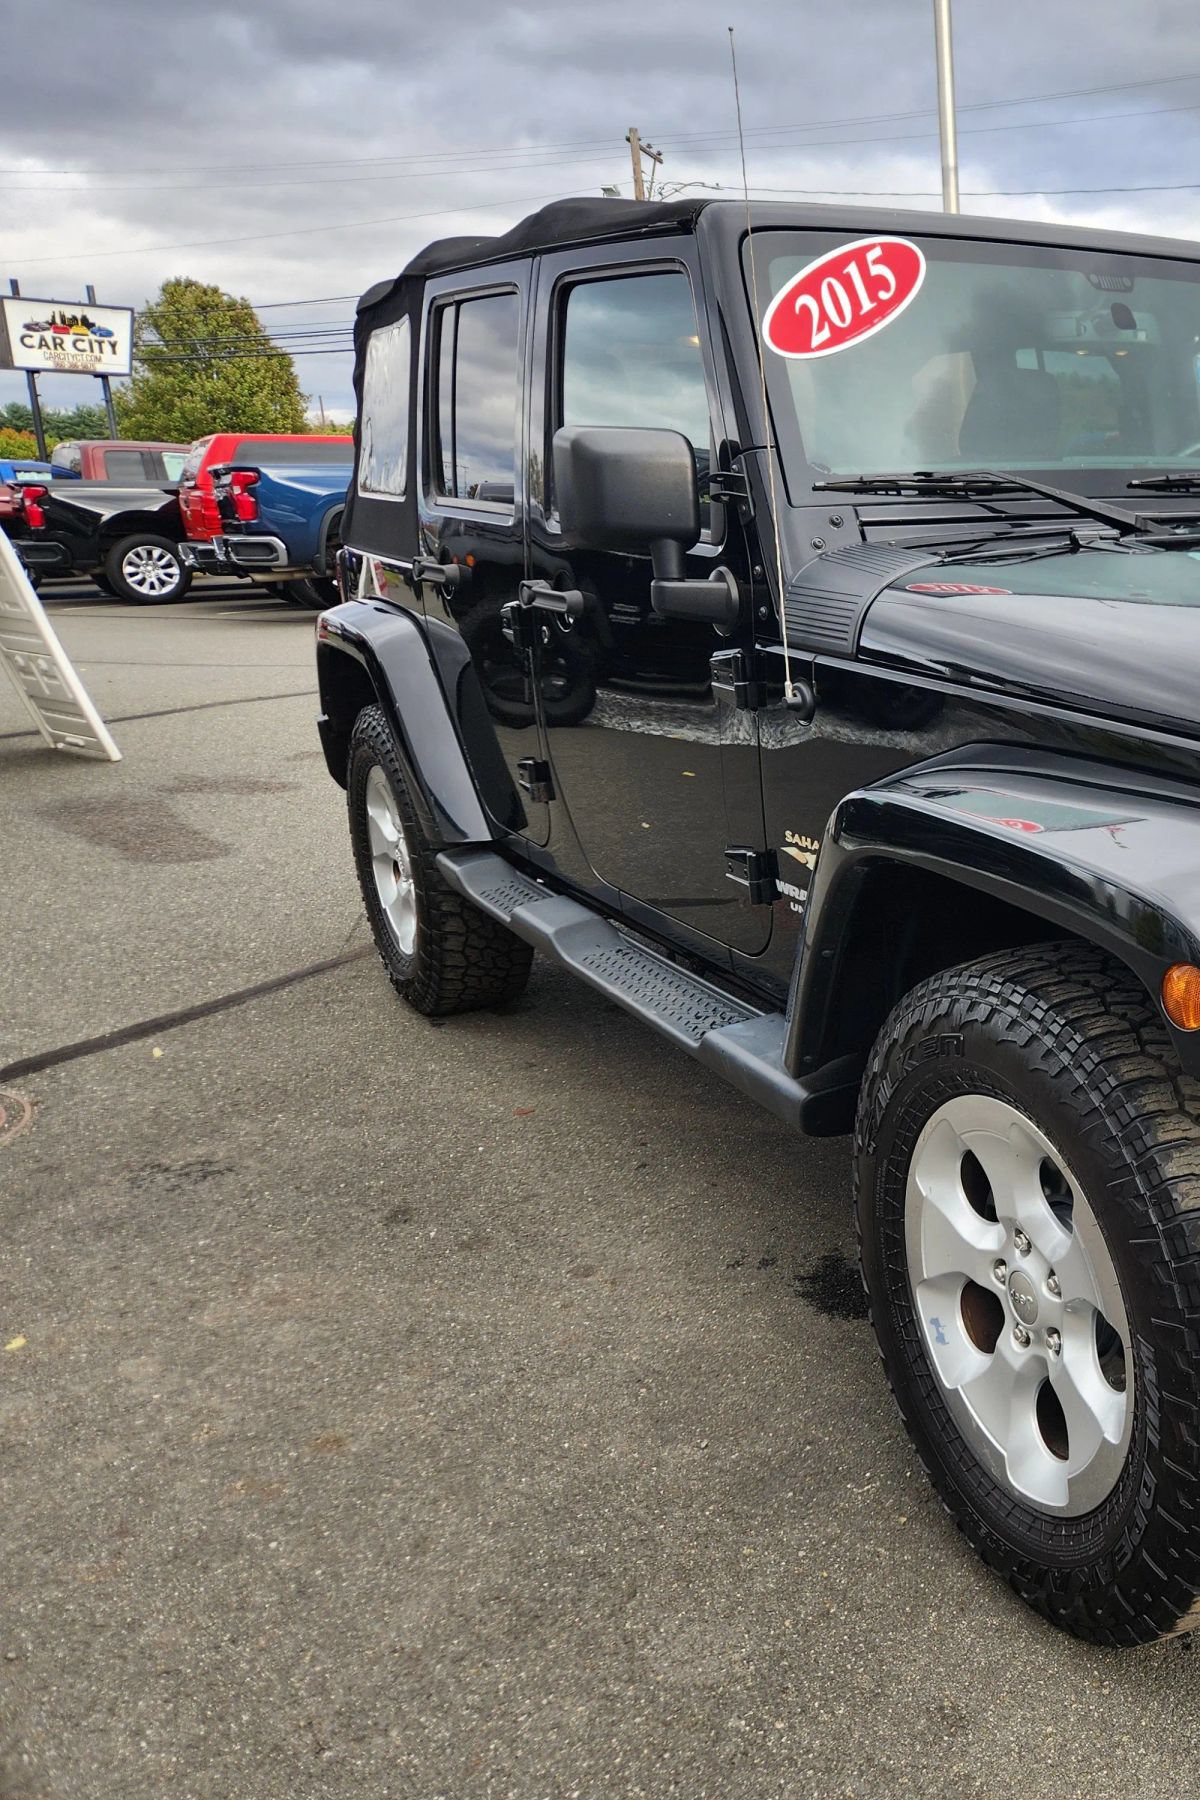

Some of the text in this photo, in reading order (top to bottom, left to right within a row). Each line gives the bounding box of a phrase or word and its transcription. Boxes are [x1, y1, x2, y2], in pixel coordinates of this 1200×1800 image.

[795, 245, 896, 349] 2015
[19, 333, 119, 355] CAR CITY
[43, 351, 103, 363] CARCITYCT.COM
[1010, 1288, 1033, 1311] Jeep
